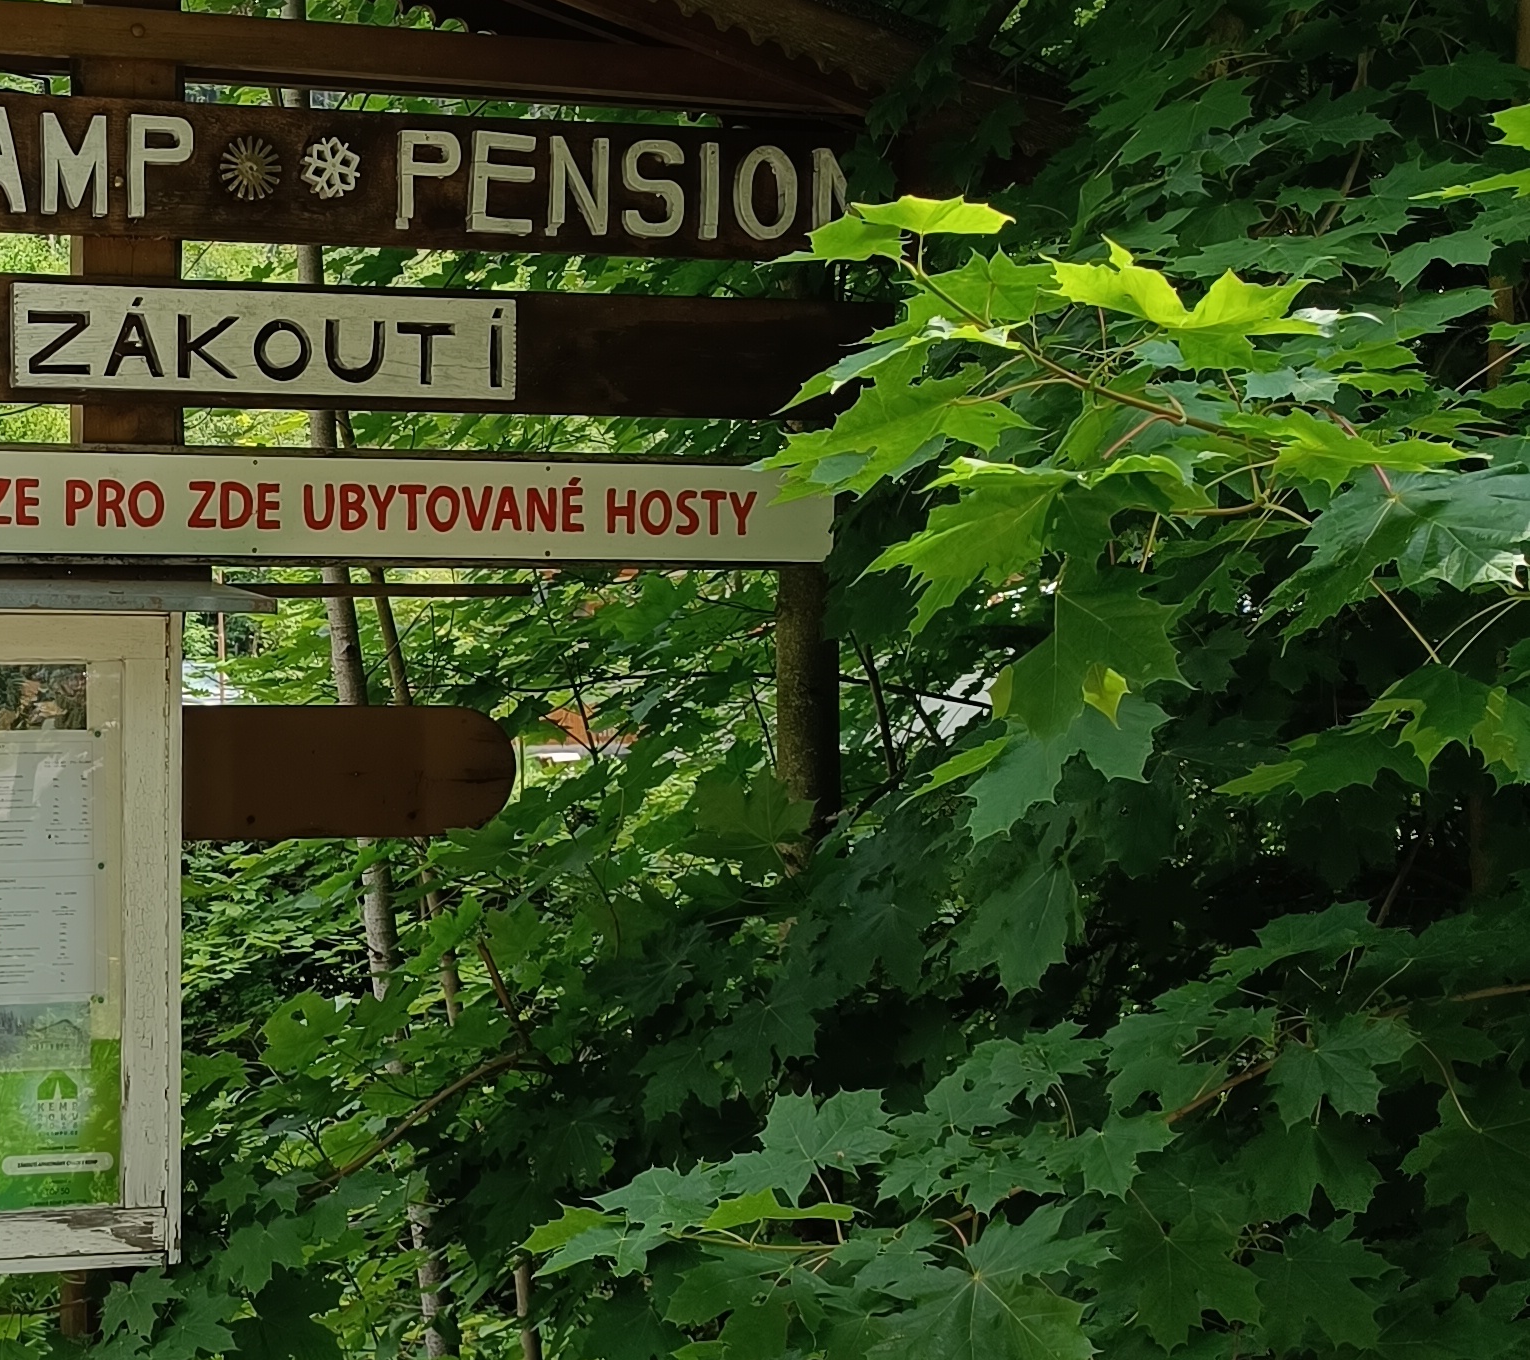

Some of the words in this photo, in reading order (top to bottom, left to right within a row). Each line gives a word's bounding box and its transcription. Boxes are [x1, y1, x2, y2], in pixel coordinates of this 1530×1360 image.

[26, 295, 505, 388] ZÁKOUTÍ
[64, 479, 165, 528] PRO
[187, 480, 281, 530] ZDE
[302, 476, 585, 533] UBYTOVANÉ
[605, 488, 758, 536] HOSTY
[37, 1101, 78, 1112] KEMP
